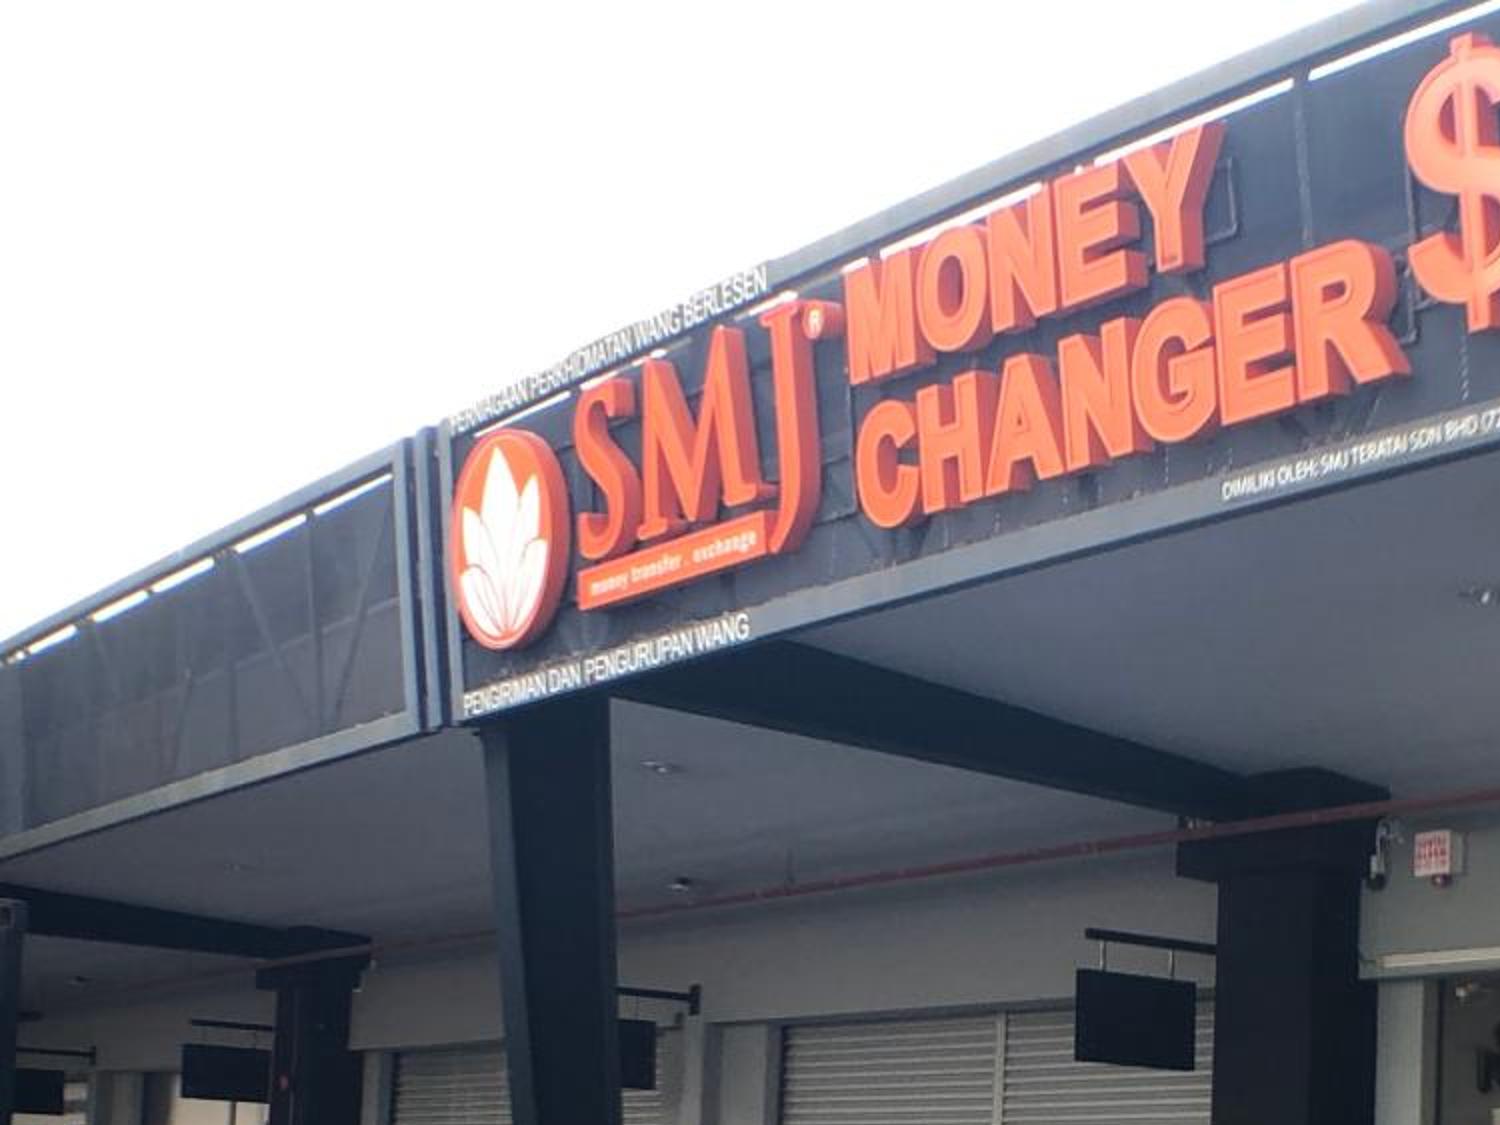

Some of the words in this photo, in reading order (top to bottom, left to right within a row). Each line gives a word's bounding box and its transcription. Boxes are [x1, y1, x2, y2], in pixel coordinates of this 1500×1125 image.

[843, 121, 1225, 386] MONEY
[634, 302, 684, 351] WANG
[684, 263, 768, 329] BERLESEN
[856, 238, 1411, 531] CHANGER
[572, 300, 822, 560] SMJ
[1320, 449, 1349, 477] SMJ
[1350, 434, 1408, 469] TERATAI
[1409, 426, 1442, 453] SDN
[1444, 415, 1478, 442] BHD
[692, 530, 757, 564] exchange
[549, 663, 582, 693] DAN
[584, 631, 693, 683] PENGURUPAN
[694, 612, 750, 652] WANG
